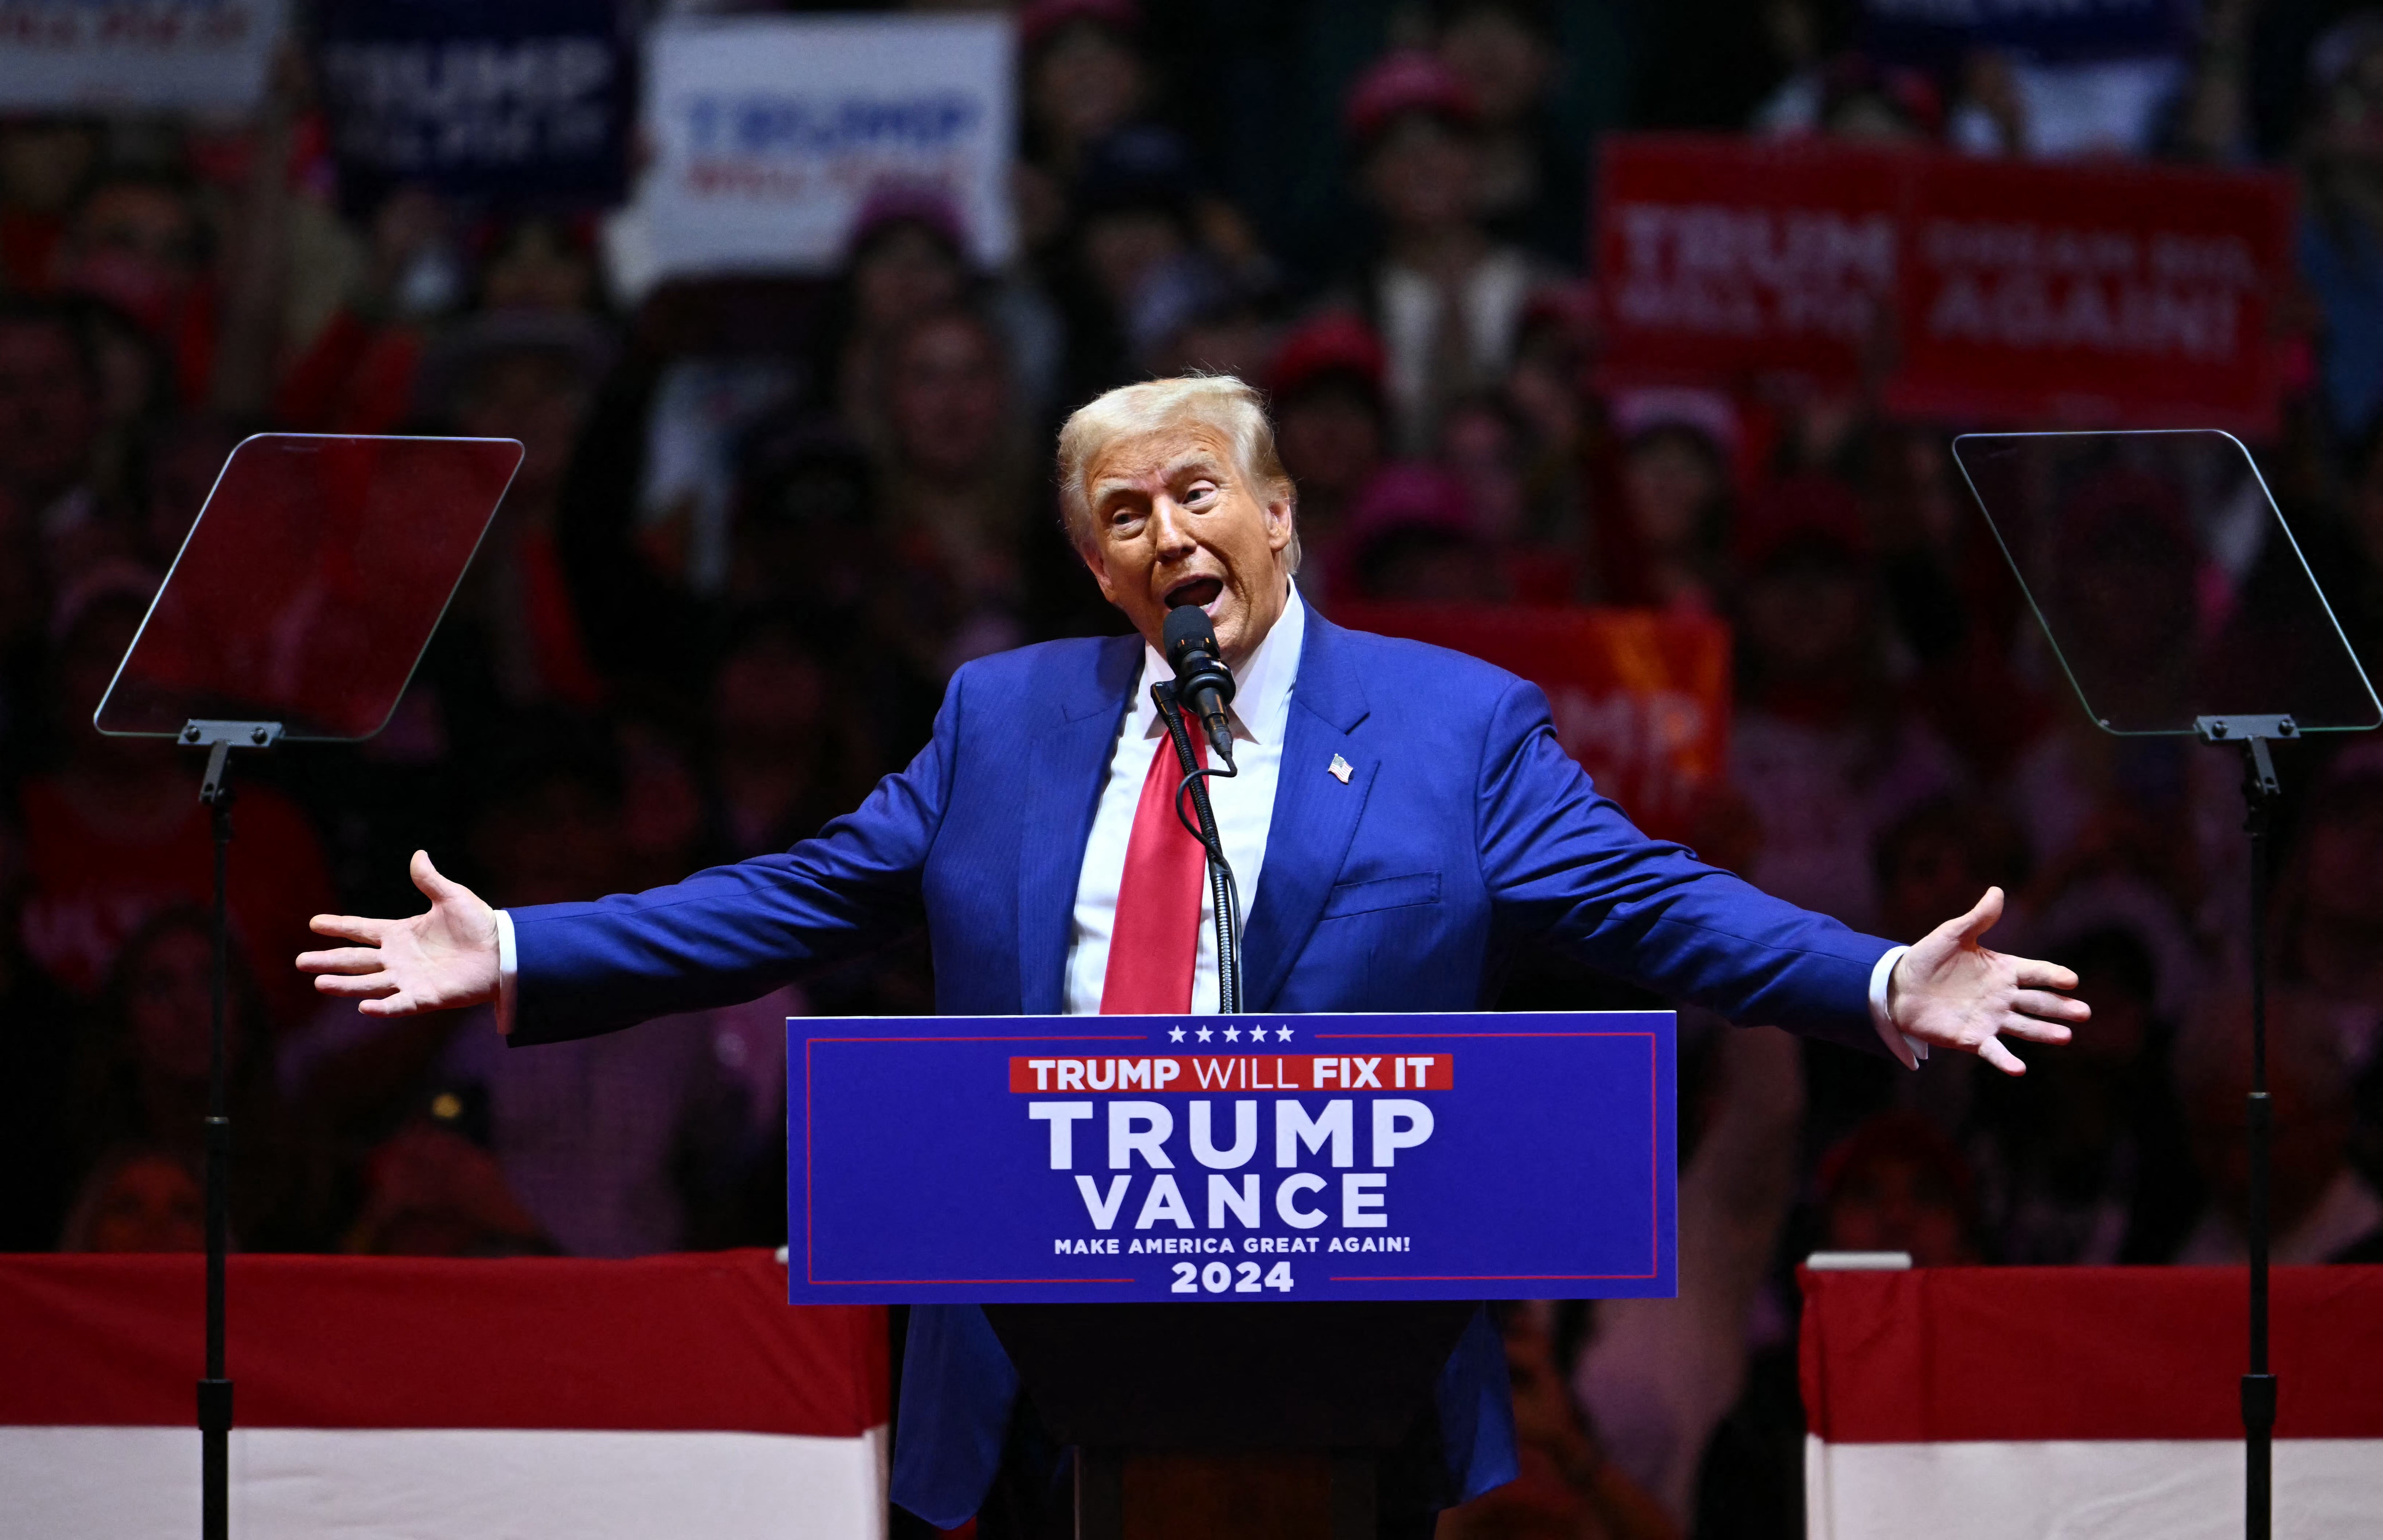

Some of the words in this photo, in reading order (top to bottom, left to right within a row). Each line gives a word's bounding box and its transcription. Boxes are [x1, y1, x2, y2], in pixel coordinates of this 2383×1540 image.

[685, 91, 979, 148] TRUMP
[1615, 202, 1894, 284] TRUM
[1927, 276, 2239, 361] AGAIN!
[1029, 1059, 1179, 1090] TRUMP
[1193, 1058, 1299, 1089] WILL
[1313, 1058, 1382, 1088] FIX
[1395, 1057, 1434, 1088] IT
[1029, 1099, 1434, 1170] TRUMP
[1074, 1172, 1387, 1230] VANCE
[1055, 1239, 1119, 1254] MAKE
[1128, 1238, 1235, 1254] AMERICA
[1244, 1237, 1319, 1253] GREAT
[1328, 1237, 1410, 1252] AGAIN!
[1171, 1261, 1294, 1293] 2024
